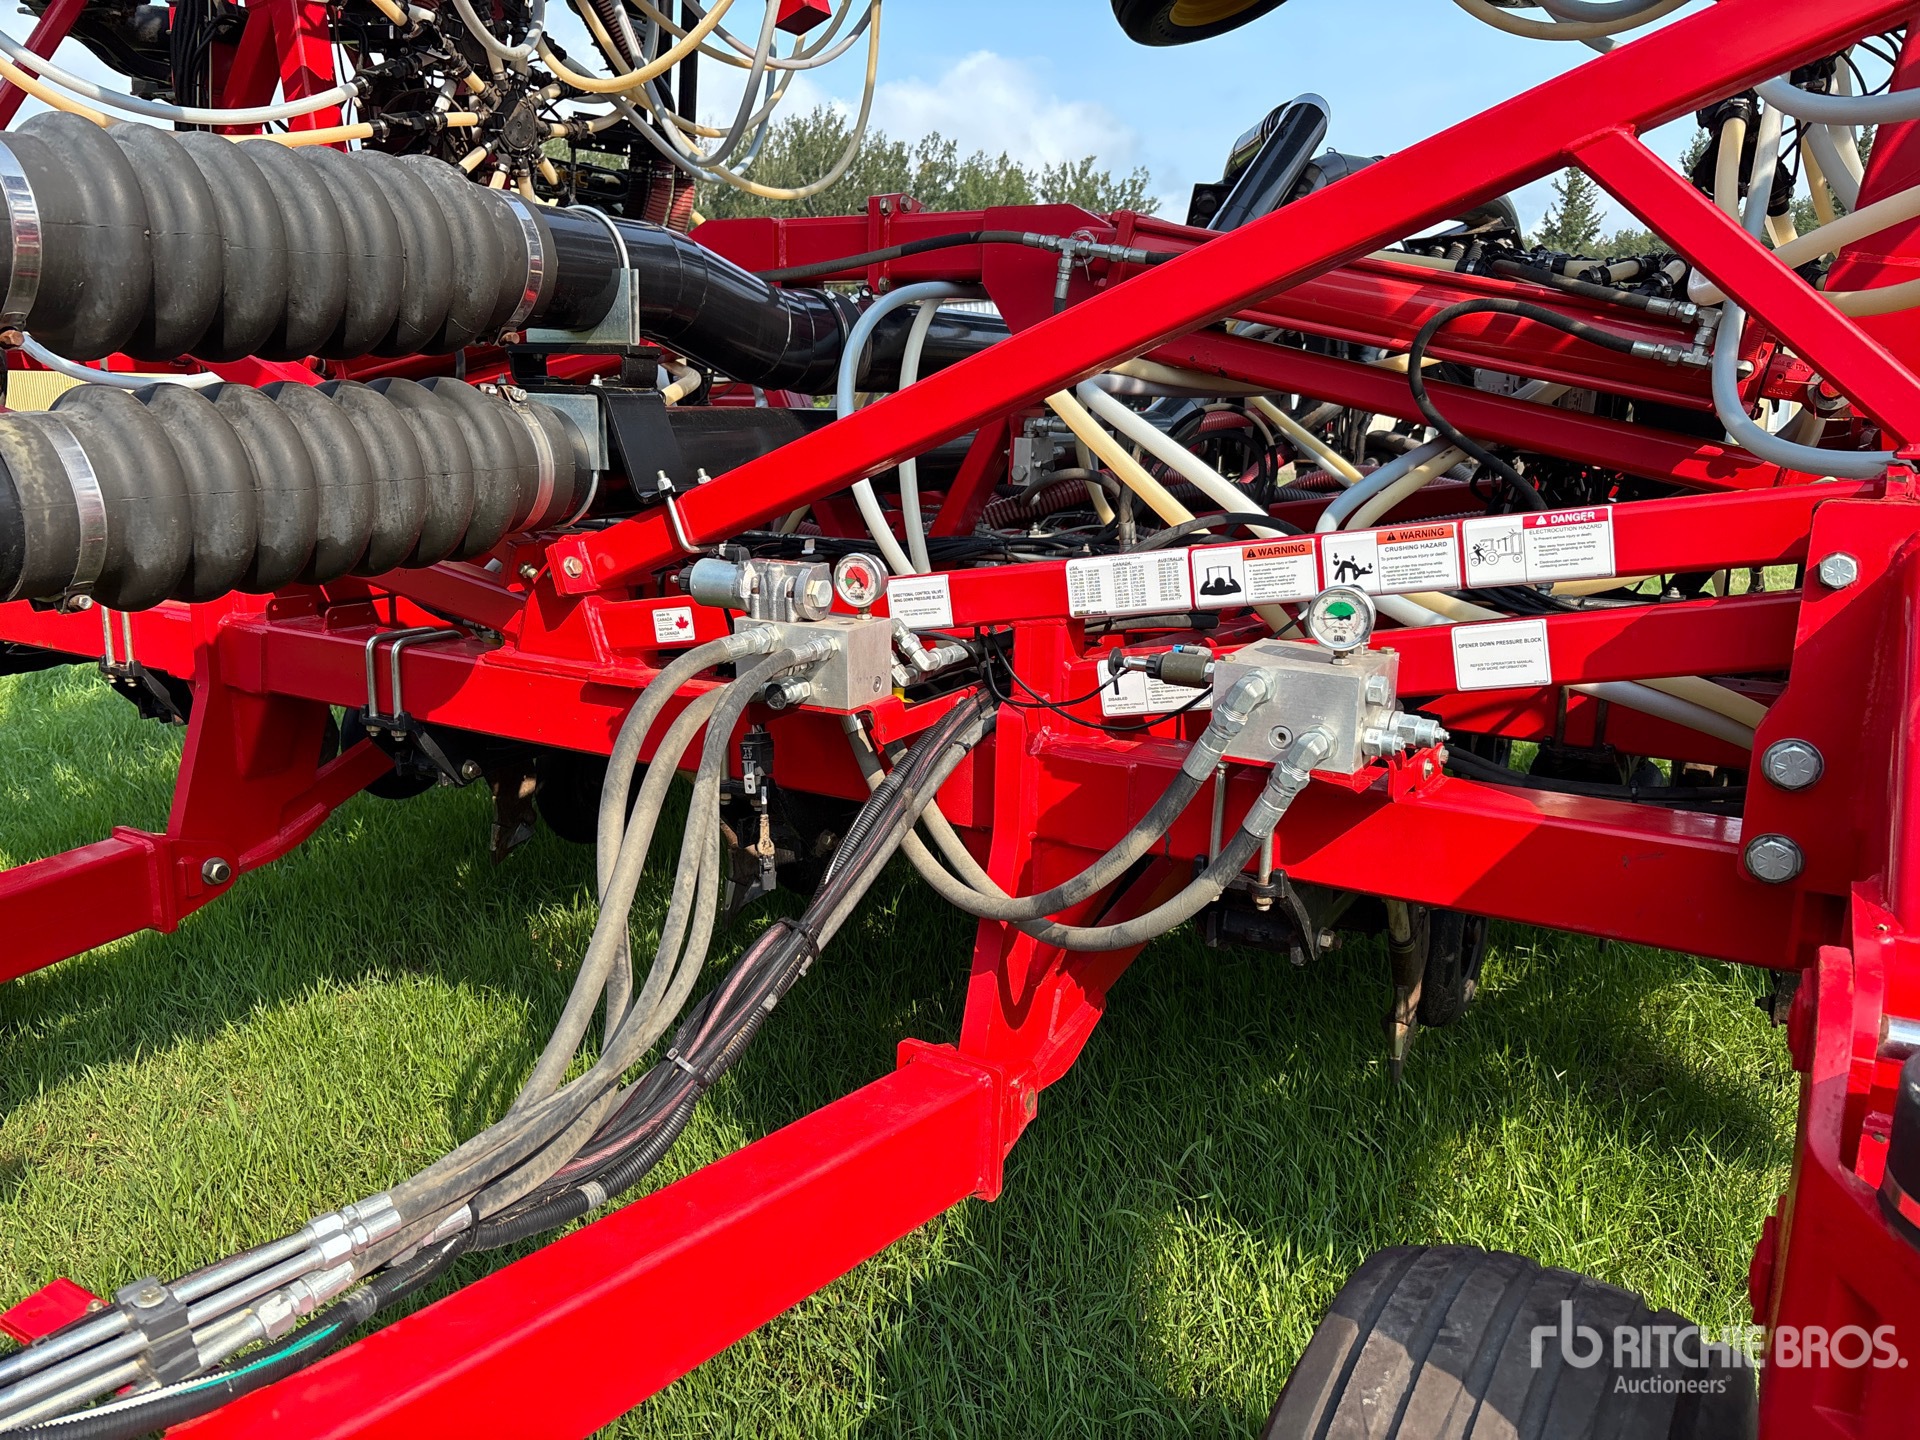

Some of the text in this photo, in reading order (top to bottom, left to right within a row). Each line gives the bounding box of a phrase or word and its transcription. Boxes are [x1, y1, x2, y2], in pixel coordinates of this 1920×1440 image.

[1551, 511, 1595, 524] DANGER
[1399, 528, 1445, 540] WARNING
[1528, 526, 1578, 535] ELECTROCUTION
[1258, 544, 1305, 556] WARNING
[1384, 541, 1448, 552] CRUSHING HAZARD
[1457, 641, 1478, 649] OPENER
[1495, 638, 1523, 646] PRESSURE
[1523, 636, 1542, 644] BLOCK
[1490, 659, 1517, 667] OPERATOR'S
